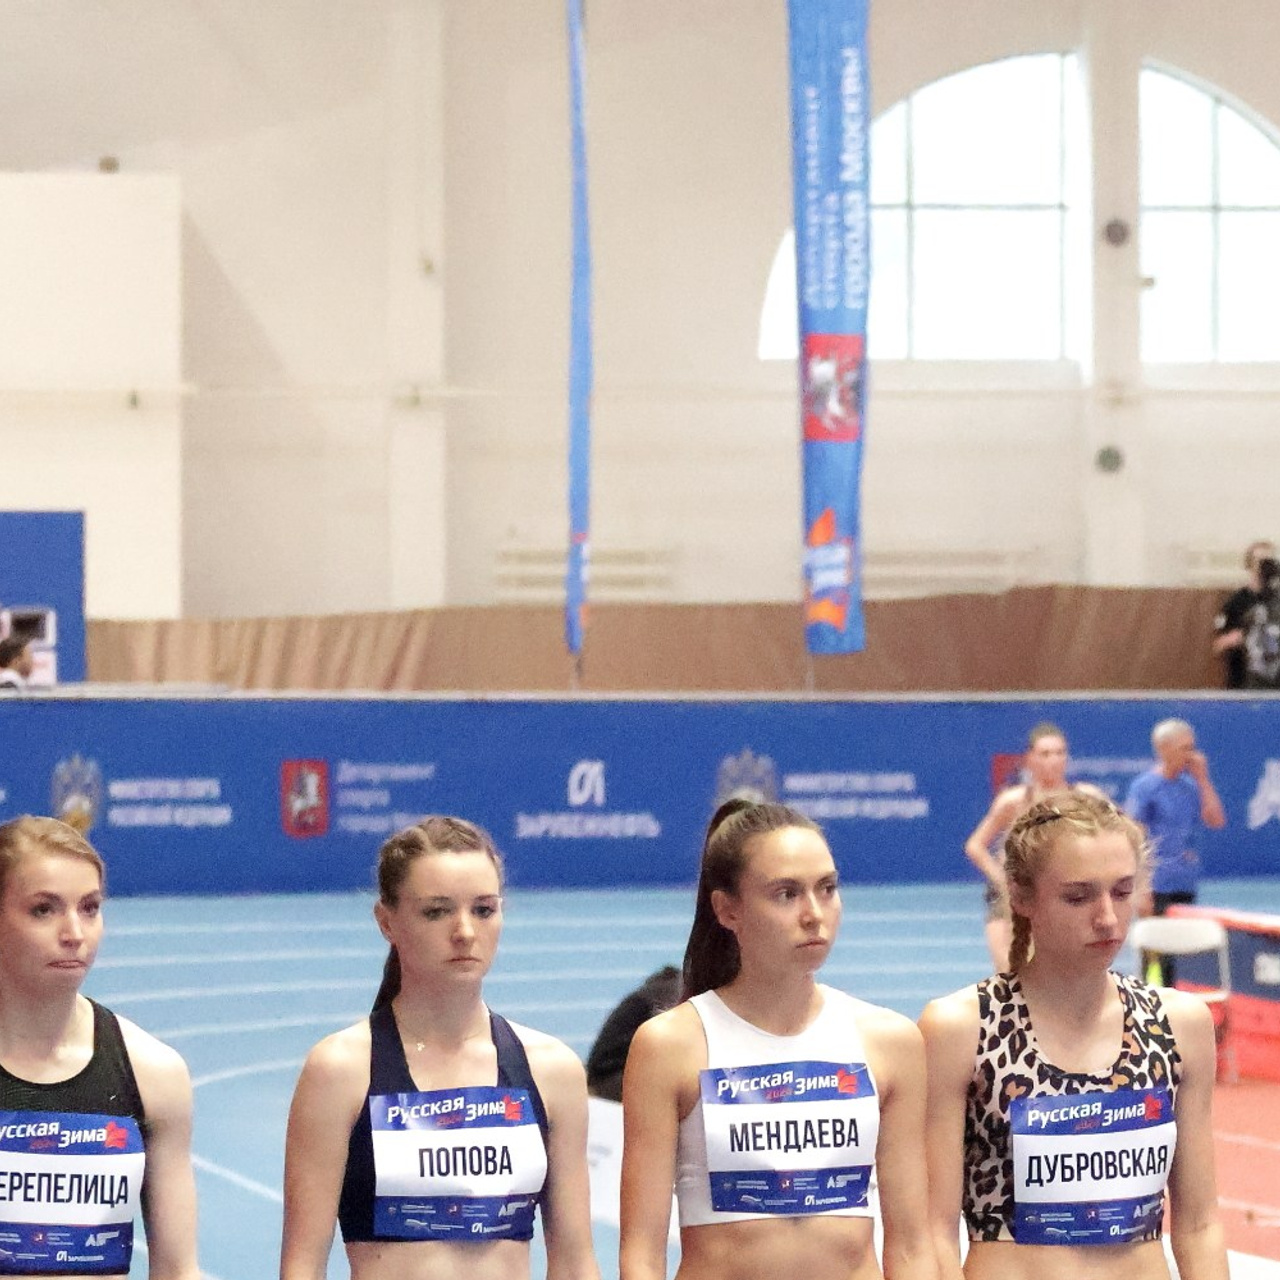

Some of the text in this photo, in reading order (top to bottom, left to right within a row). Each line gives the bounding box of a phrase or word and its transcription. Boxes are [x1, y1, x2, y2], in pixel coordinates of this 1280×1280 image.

[717, 1070, 794, 1098] Русская
[387, 1096, 464, 1125] Русская
[1027, 1102, 1102, 1128] Русская
[729, 1118, 859, 1153] МЕНДАЕВА
[419, 1146, 512, 1177] ПОПОВА
[1025, 1145, 1168, 1187] ДУБРОВСКАЯ
